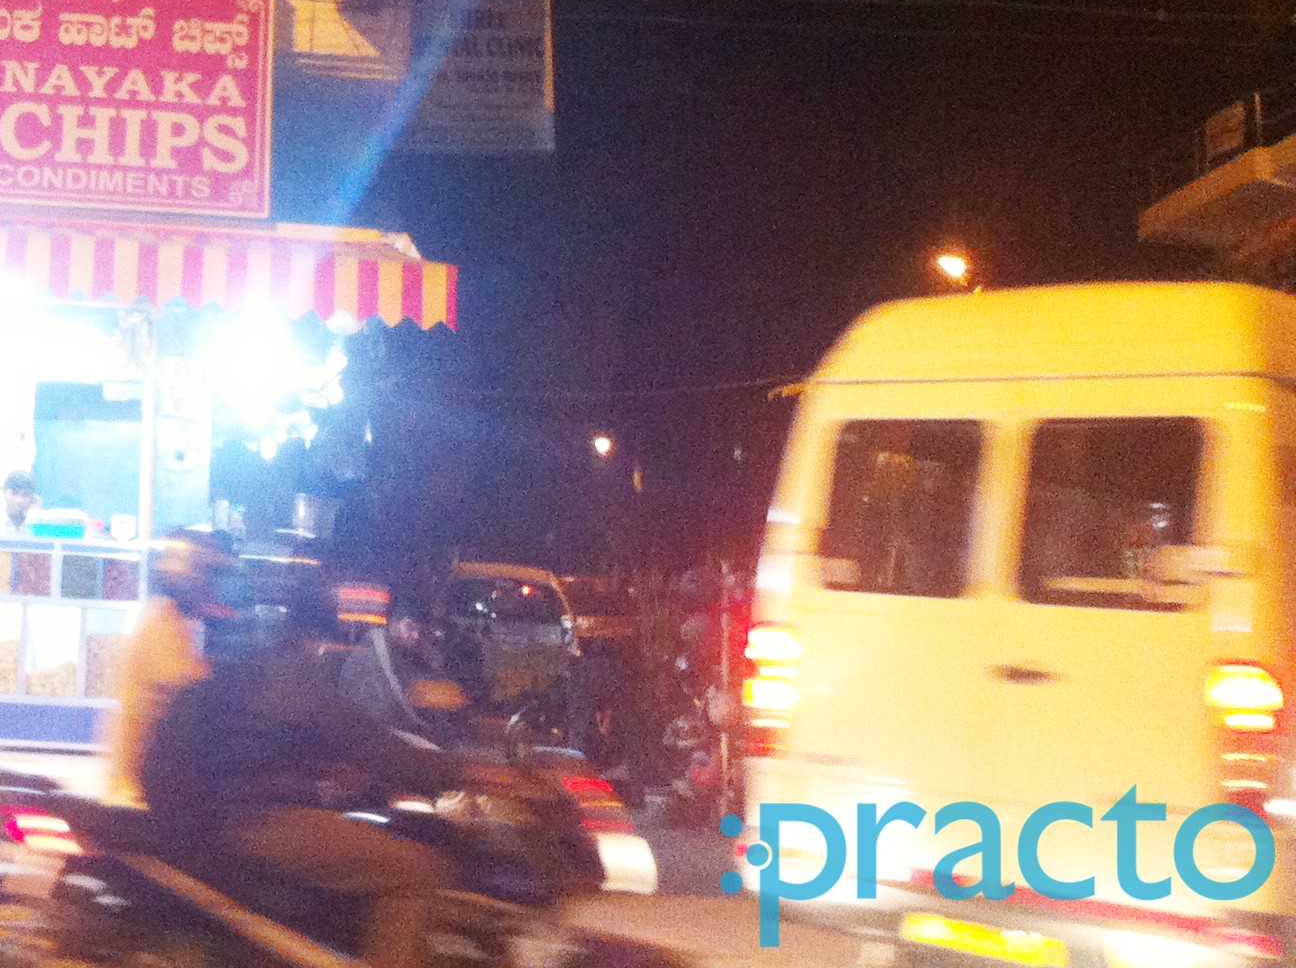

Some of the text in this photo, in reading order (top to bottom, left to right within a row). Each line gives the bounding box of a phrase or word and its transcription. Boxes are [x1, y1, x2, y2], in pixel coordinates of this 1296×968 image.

[57, 7, 156, 50] ಹಾಟ್
[172, 13, 250, 70] ಚಿಪ್ಸ್
[0, 101, 249, 174] CHIPS
